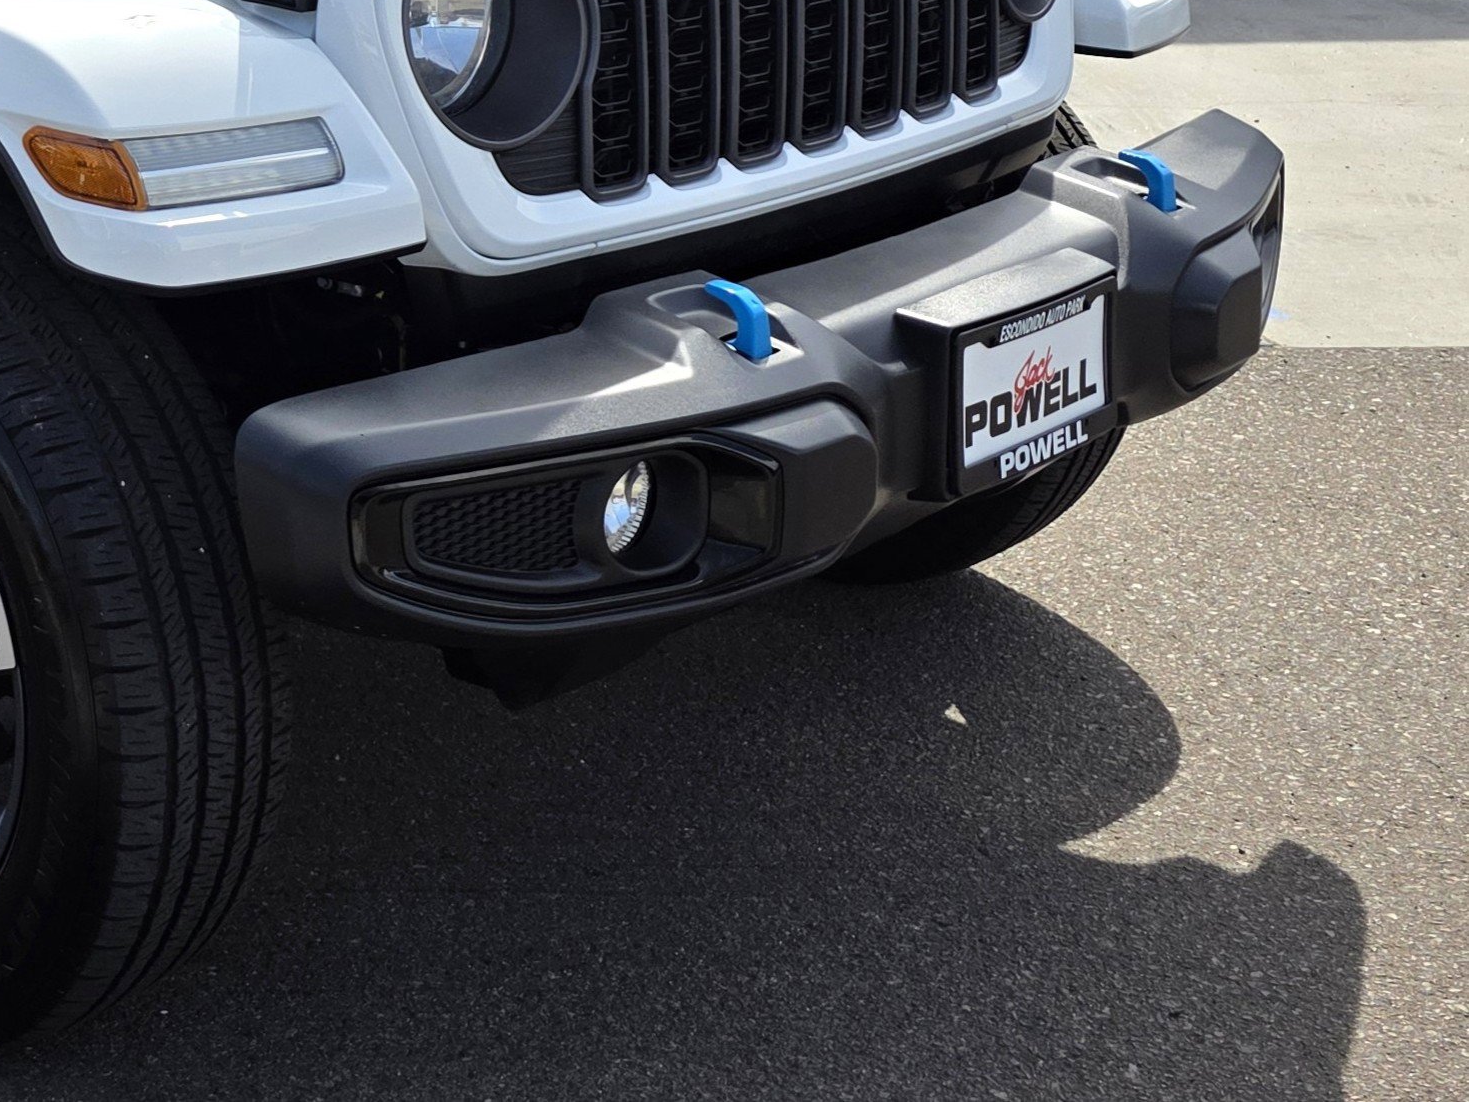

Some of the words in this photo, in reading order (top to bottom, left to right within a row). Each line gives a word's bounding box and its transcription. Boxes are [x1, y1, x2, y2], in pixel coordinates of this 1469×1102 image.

[999, 310, 1047, 343] ESCONDIDO
[1045, 302, 1067, 327] AUTO
[964, 358, 1098, 449] POWELL
[999, 419, 1089, 480] POWELL
